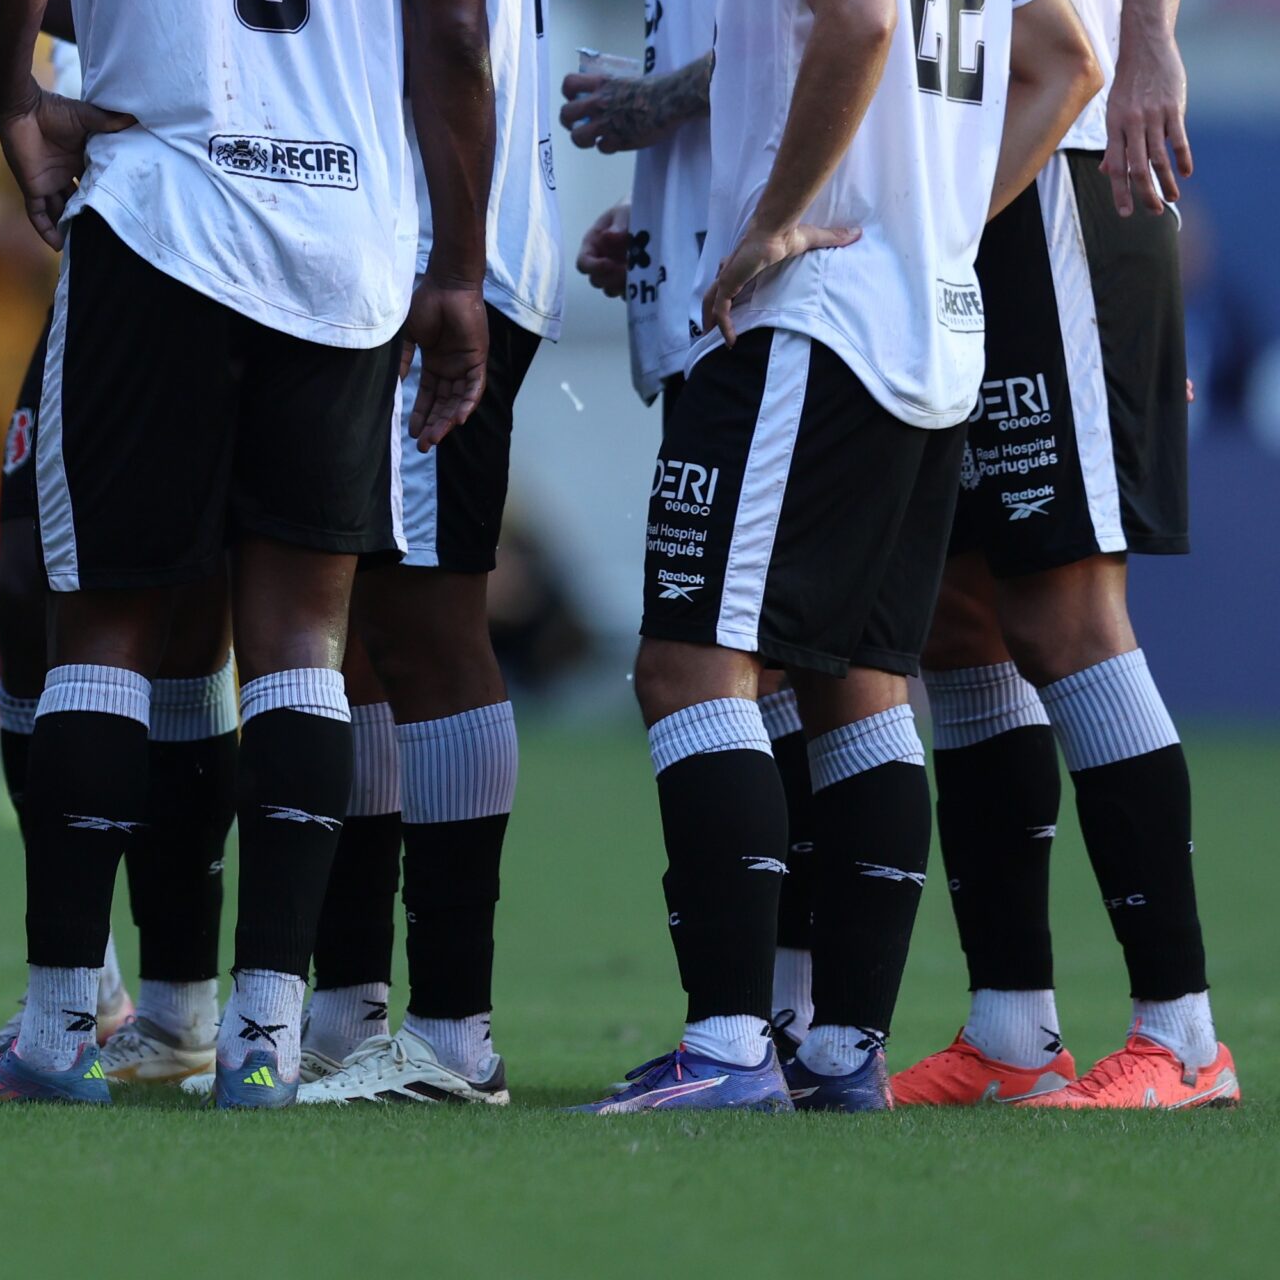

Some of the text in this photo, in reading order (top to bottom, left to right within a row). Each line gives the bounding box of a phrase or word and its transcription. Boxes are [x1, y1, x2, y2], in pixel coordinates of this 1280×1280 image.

[270, 143, 351, 174] RECIFE
[976, 435, 1056, 461] Real Hospital
[978, 452, 1058, 477] Português
[1001, 485, 1056, 504] Reebok
[660, 523, 707, 542] Hospital
[657, 569, 705, 585] Reebok
